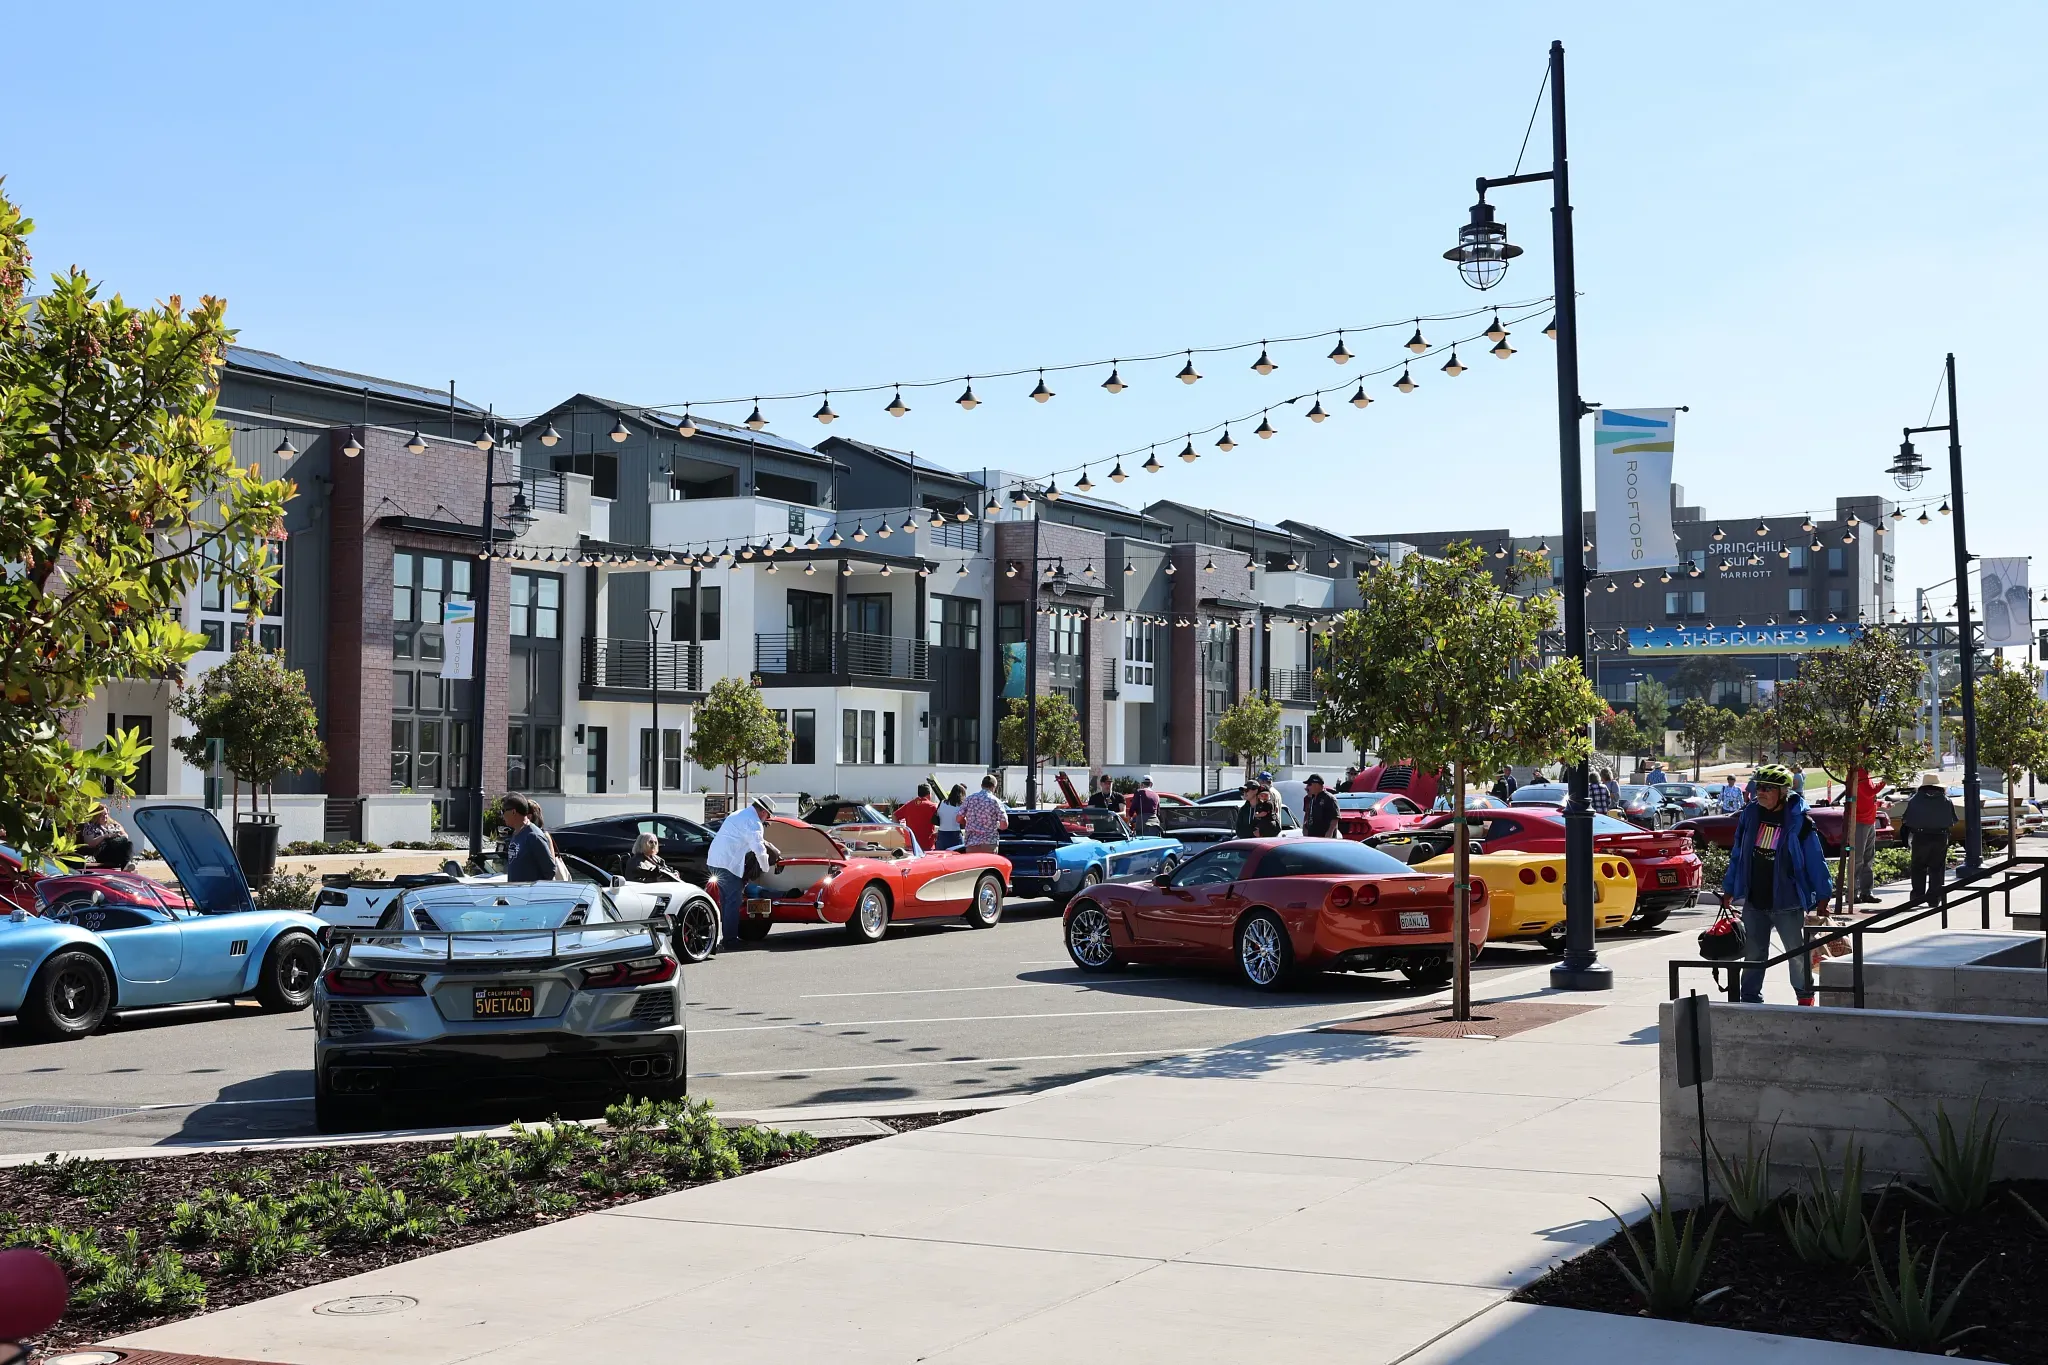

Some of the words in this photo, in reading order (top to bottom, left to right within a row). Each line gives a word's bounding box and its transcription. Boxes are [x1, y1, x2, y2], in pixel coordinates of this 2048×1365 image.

[1626, 460, 1644, 561] ROOFTOPS
[1727, 556, 1765, 567] SUIS
[1720, 570, 1772, 579] MARRIOTT
[1679, 632, 1722, 647] THE
[1730, 630, 1809, 647] DUNES
[476, 997, 531, 1014] 5VET4CD
